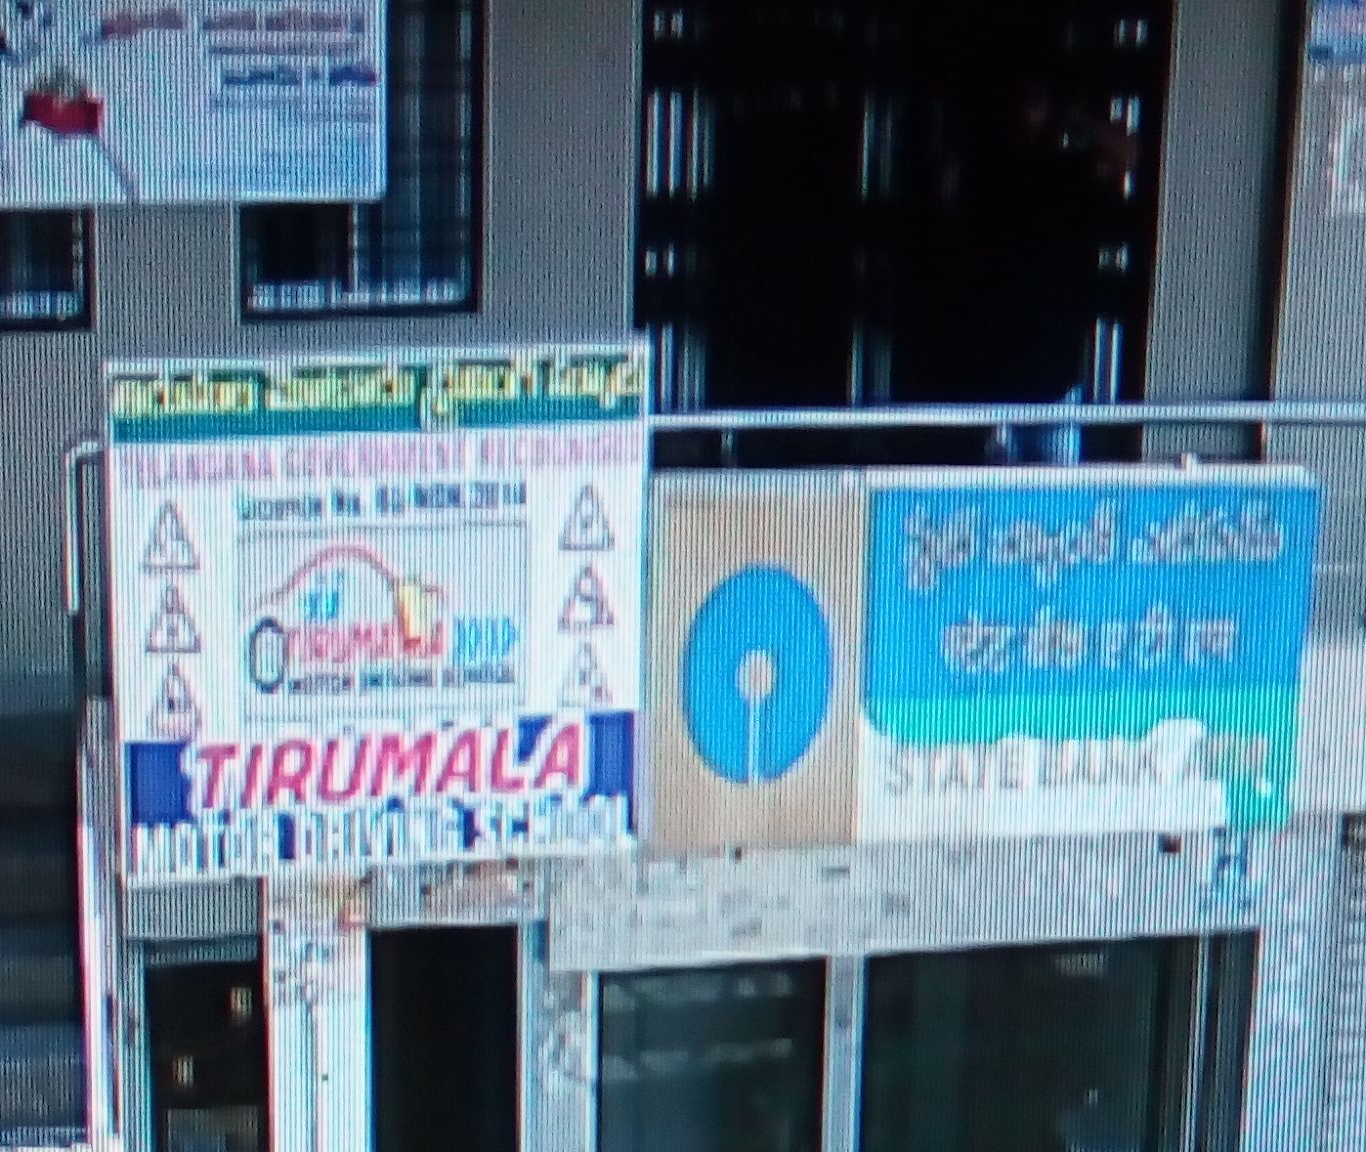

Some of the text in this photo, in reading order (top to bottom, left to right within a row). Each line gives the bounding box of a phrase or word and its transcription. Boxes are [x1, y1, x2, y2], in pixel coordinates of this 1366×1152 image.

[197, 722, 583, 809] TIRUMALA
[885, 738, 1025, 796] STATE
[1038, 736, 1161, 787] BANK
[133, 792, 634, 874] MOTOR DRIVING SCHOOL
